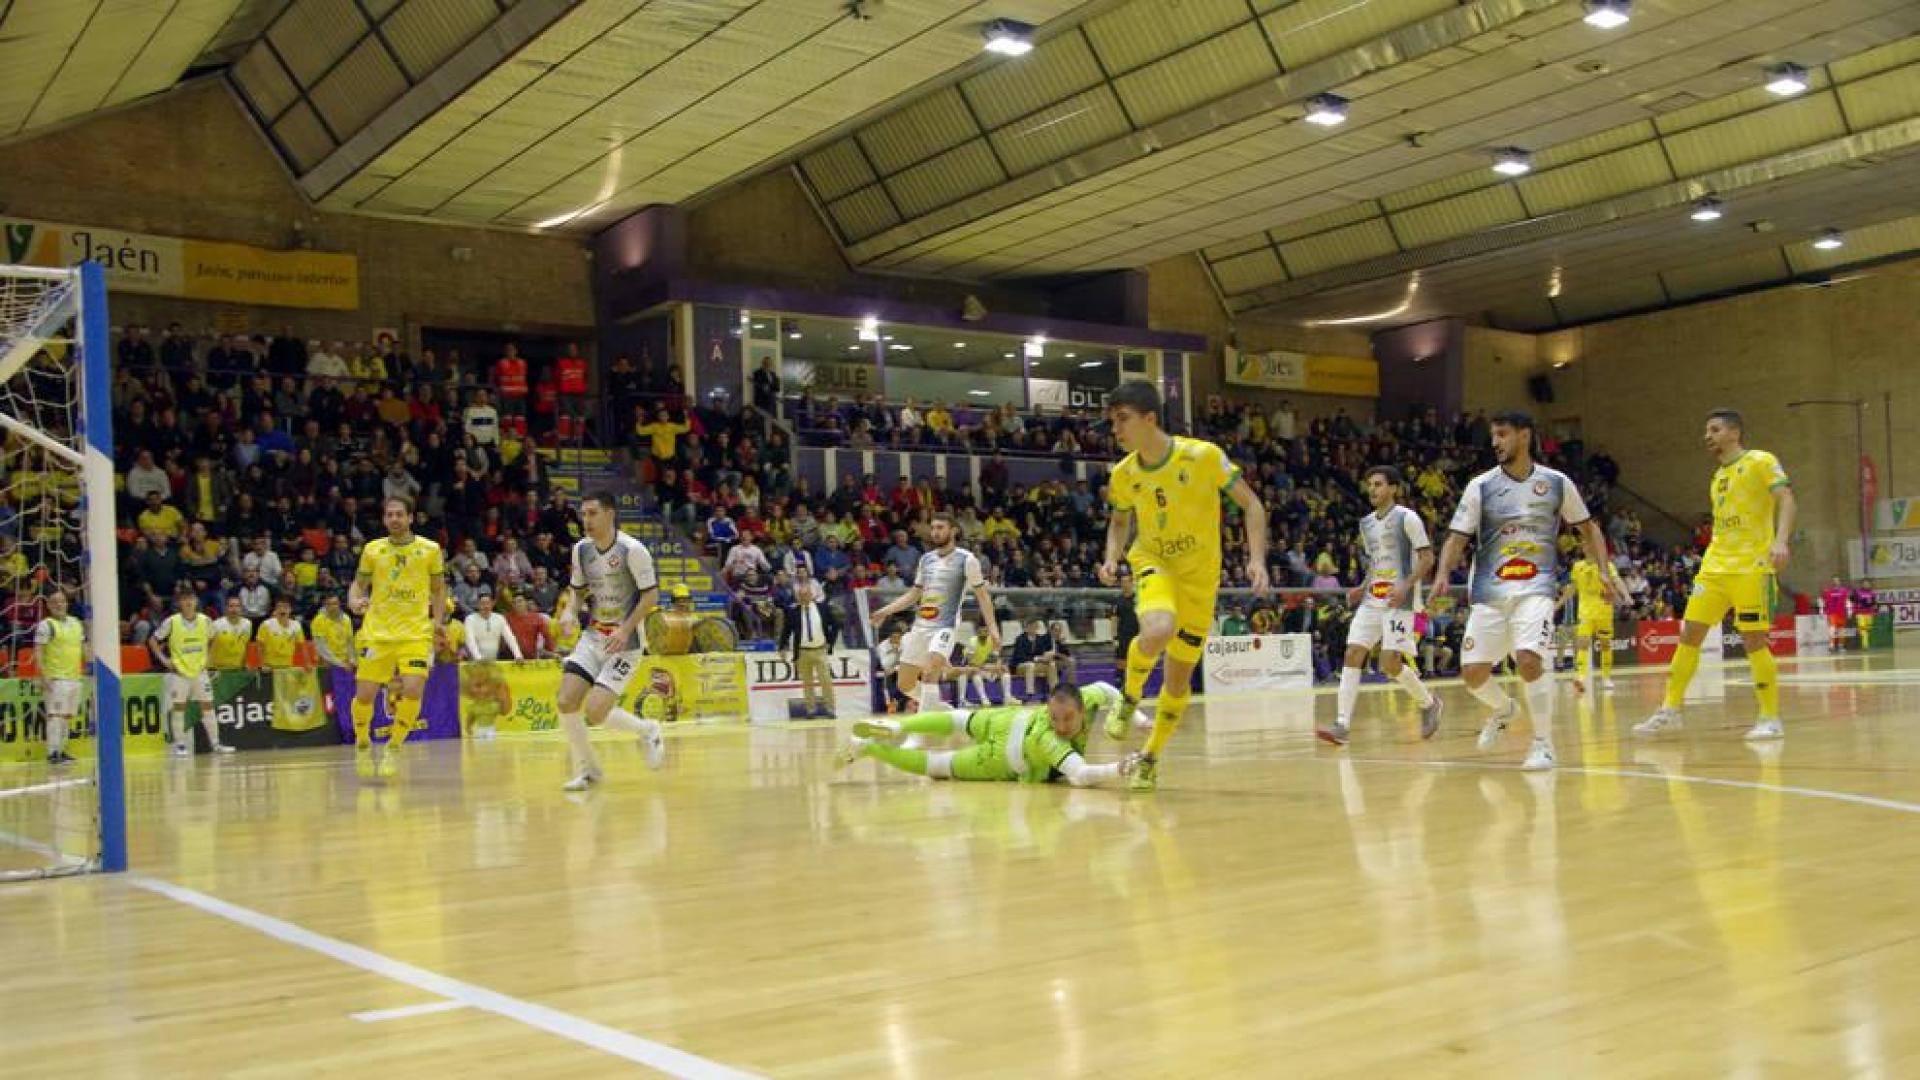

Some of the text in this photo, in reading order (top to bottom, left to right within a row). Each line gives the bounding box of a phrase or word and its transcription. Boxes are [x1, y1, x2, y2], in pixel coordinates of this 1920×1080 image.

[72, 231, 159, 274] Jaén
[1155, 487, 1167, 509] 6
[1389, 619, 1406, 633] 14
[1207, 640, 1251, 656] cajasur
